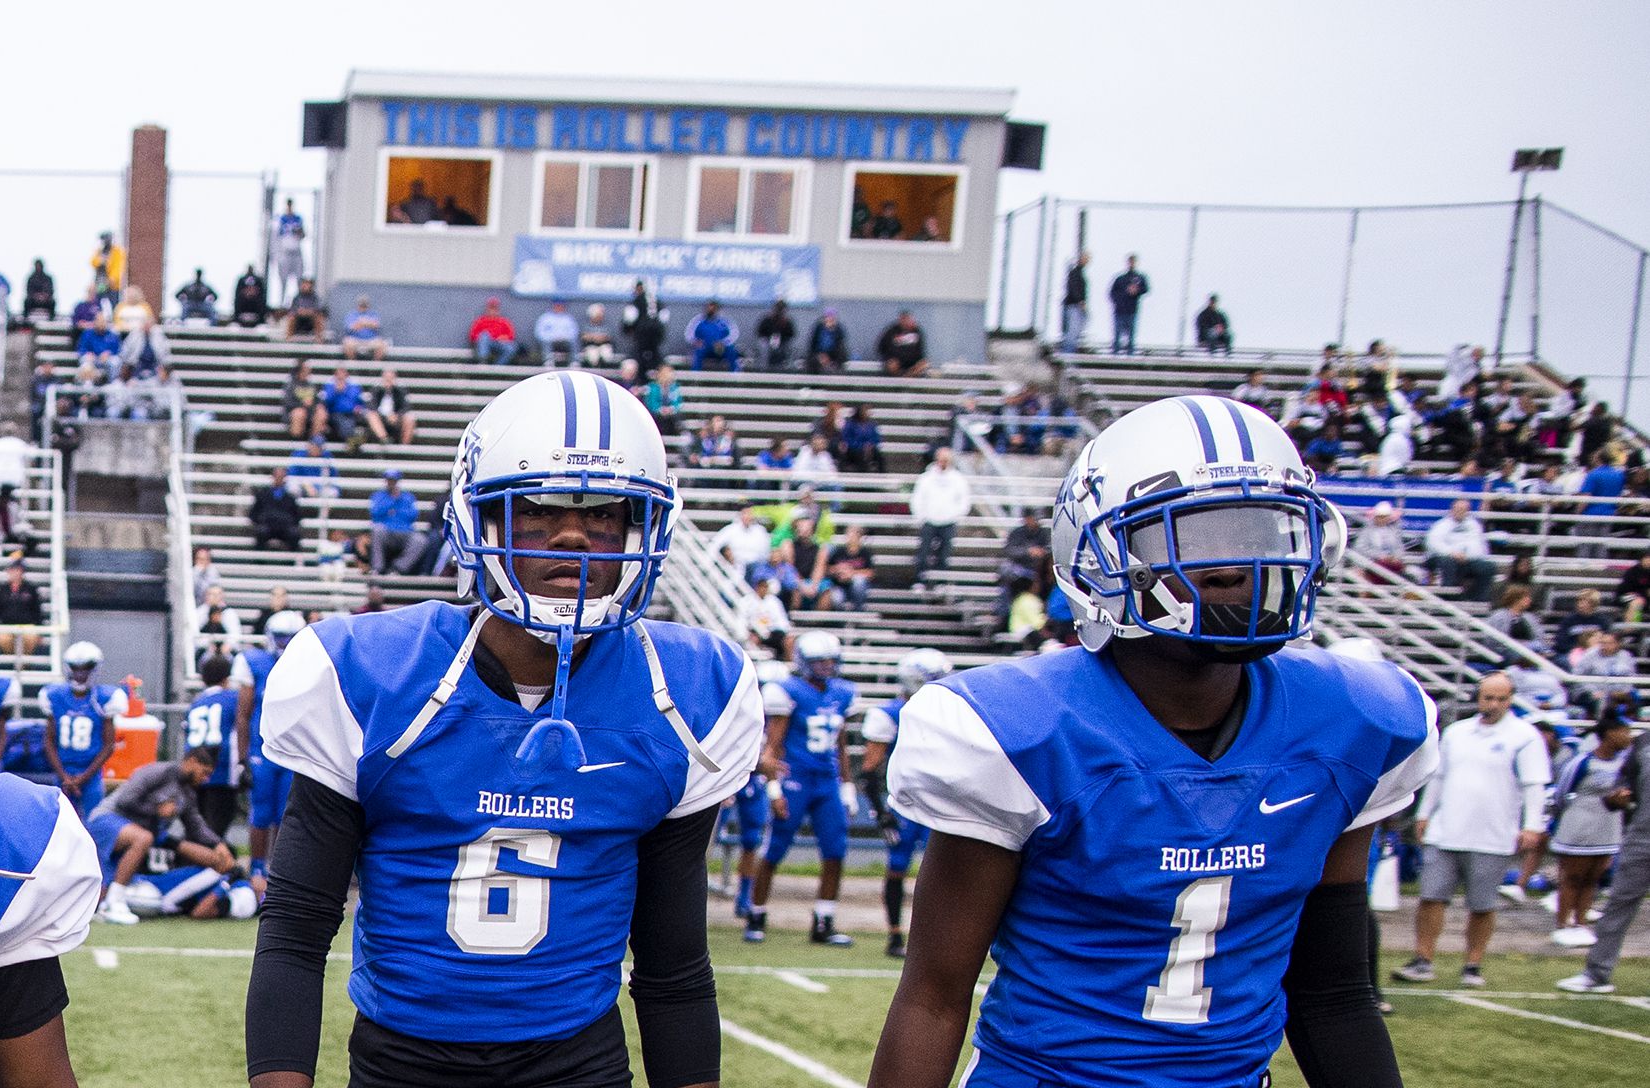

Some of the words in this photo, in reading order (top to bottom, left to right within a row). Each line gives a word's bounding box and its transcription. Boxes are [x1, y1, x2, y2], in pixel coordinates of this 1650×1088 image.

[382, 100, 481, 147] THIS
[497, 104, 537, 149] IS
[552, 106, 729, 154] ROLLER
[747, 111, 970, 161] COUNTRY
[566, 453, 609, 467] STEEL-HIGH
[1209, 465, 1258, 478] STEEL-HIGH
[59, 714, 93, 750] 18
[187, 702, 223, 747] 51
[477, 790, 574, 820] ROLLERS
[1159, 843, 1266, 873] ROLLERS
[446, 826, 562, 956] 6
[1142, 874, 1234, 1025] 1
